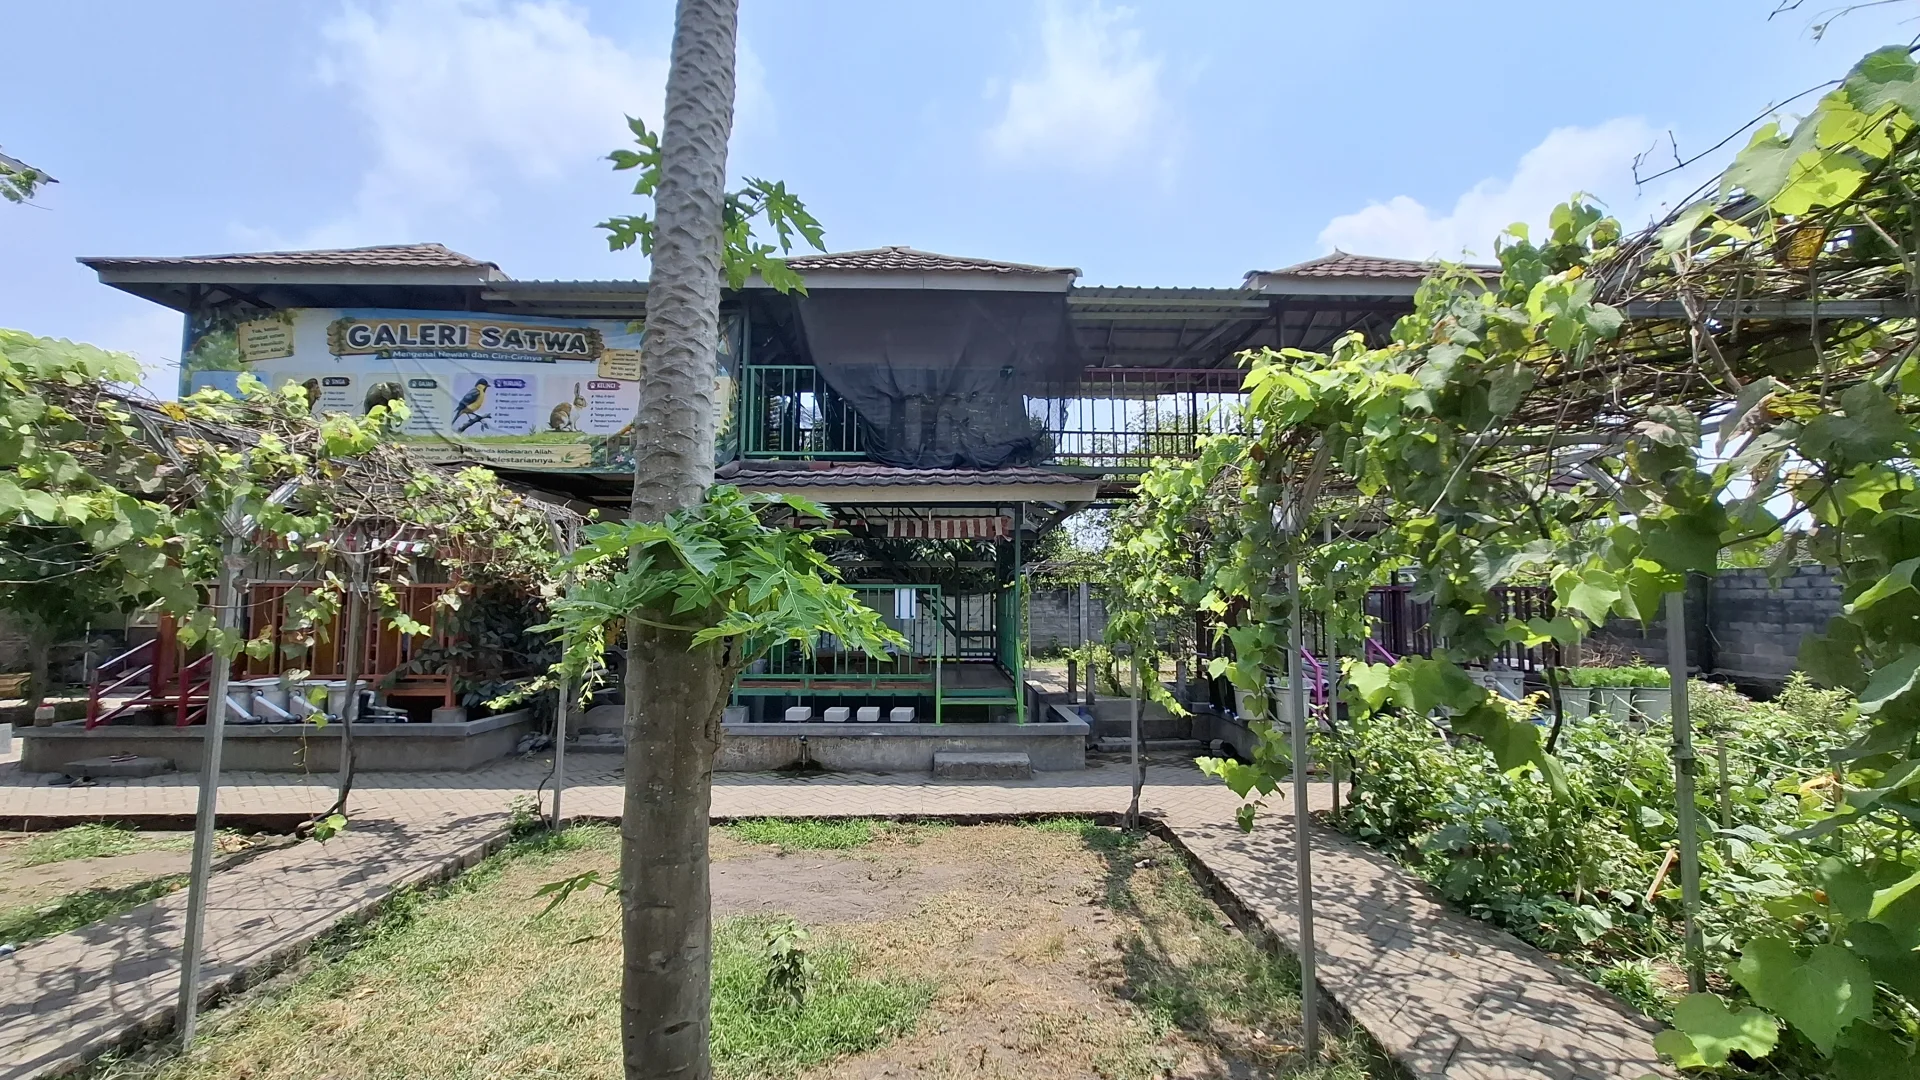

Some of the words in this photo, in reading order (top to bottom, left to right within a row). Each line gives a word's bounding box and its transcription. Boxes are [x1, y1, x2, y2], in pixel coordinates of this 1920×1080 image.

[349, 324, 468, 348] GALERI
[481, 326, 588, 353] SATWA
[392, 351, 436, 359] Mengenal
[491, 353, 542, 361] Ciri-Cirinya
[486, 455, 556, 465] kelestariannya.
